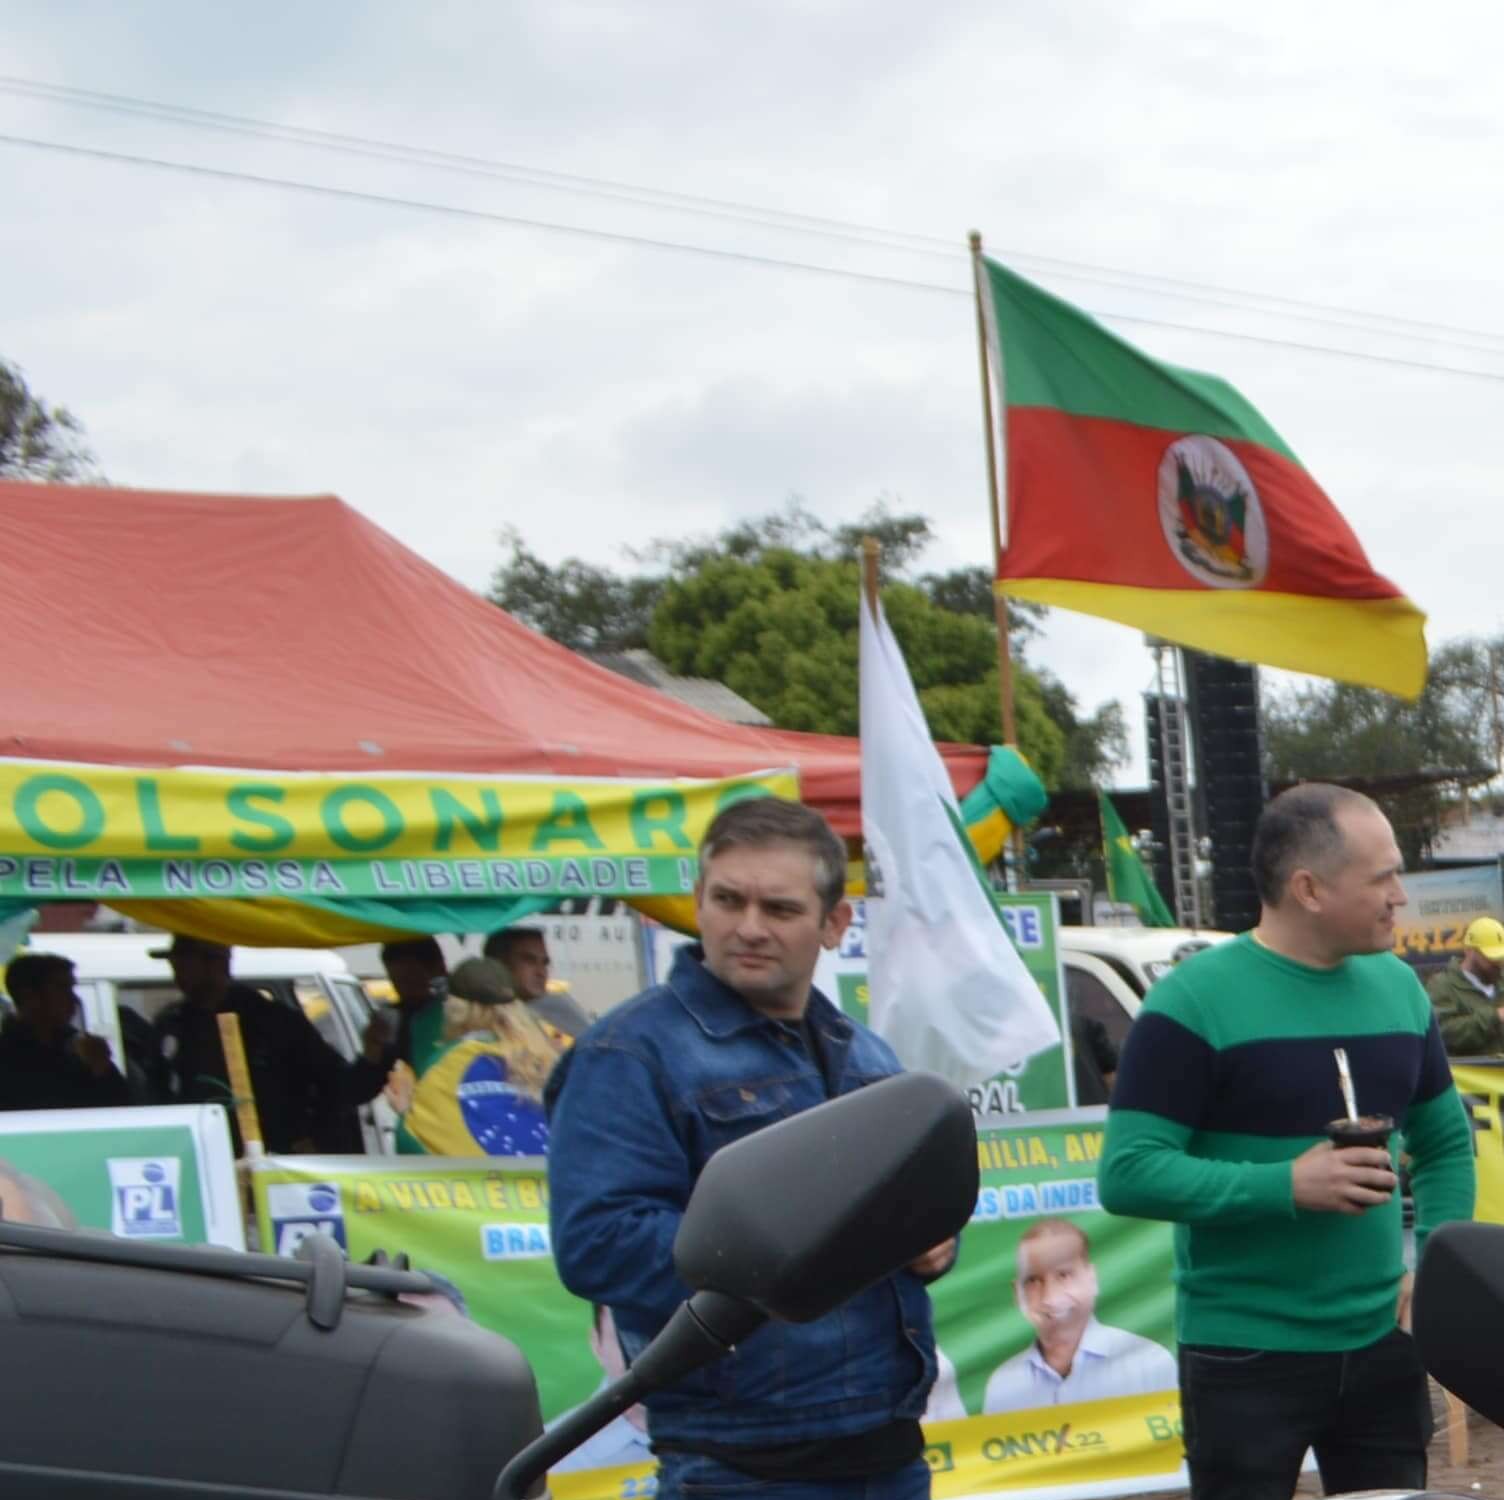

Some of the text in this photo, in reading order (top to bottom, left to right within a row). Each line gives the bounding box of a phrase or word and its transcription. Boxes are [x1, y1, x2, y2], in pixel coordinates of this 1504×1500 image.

[162, 858, 346, 895] NOSSA
[371, 857, 652, 894] LIBERDADE
[115, 1186, 177, 1221] PL
[386, 1180, 476, 1210] VIDA
[516, 1177, 548, 1210] B
[1005, 1185, 1036, 1213] DA
[981, 1423, 1073, 1462] ONYX
[1074, 1430, 1105, 1448] 22
